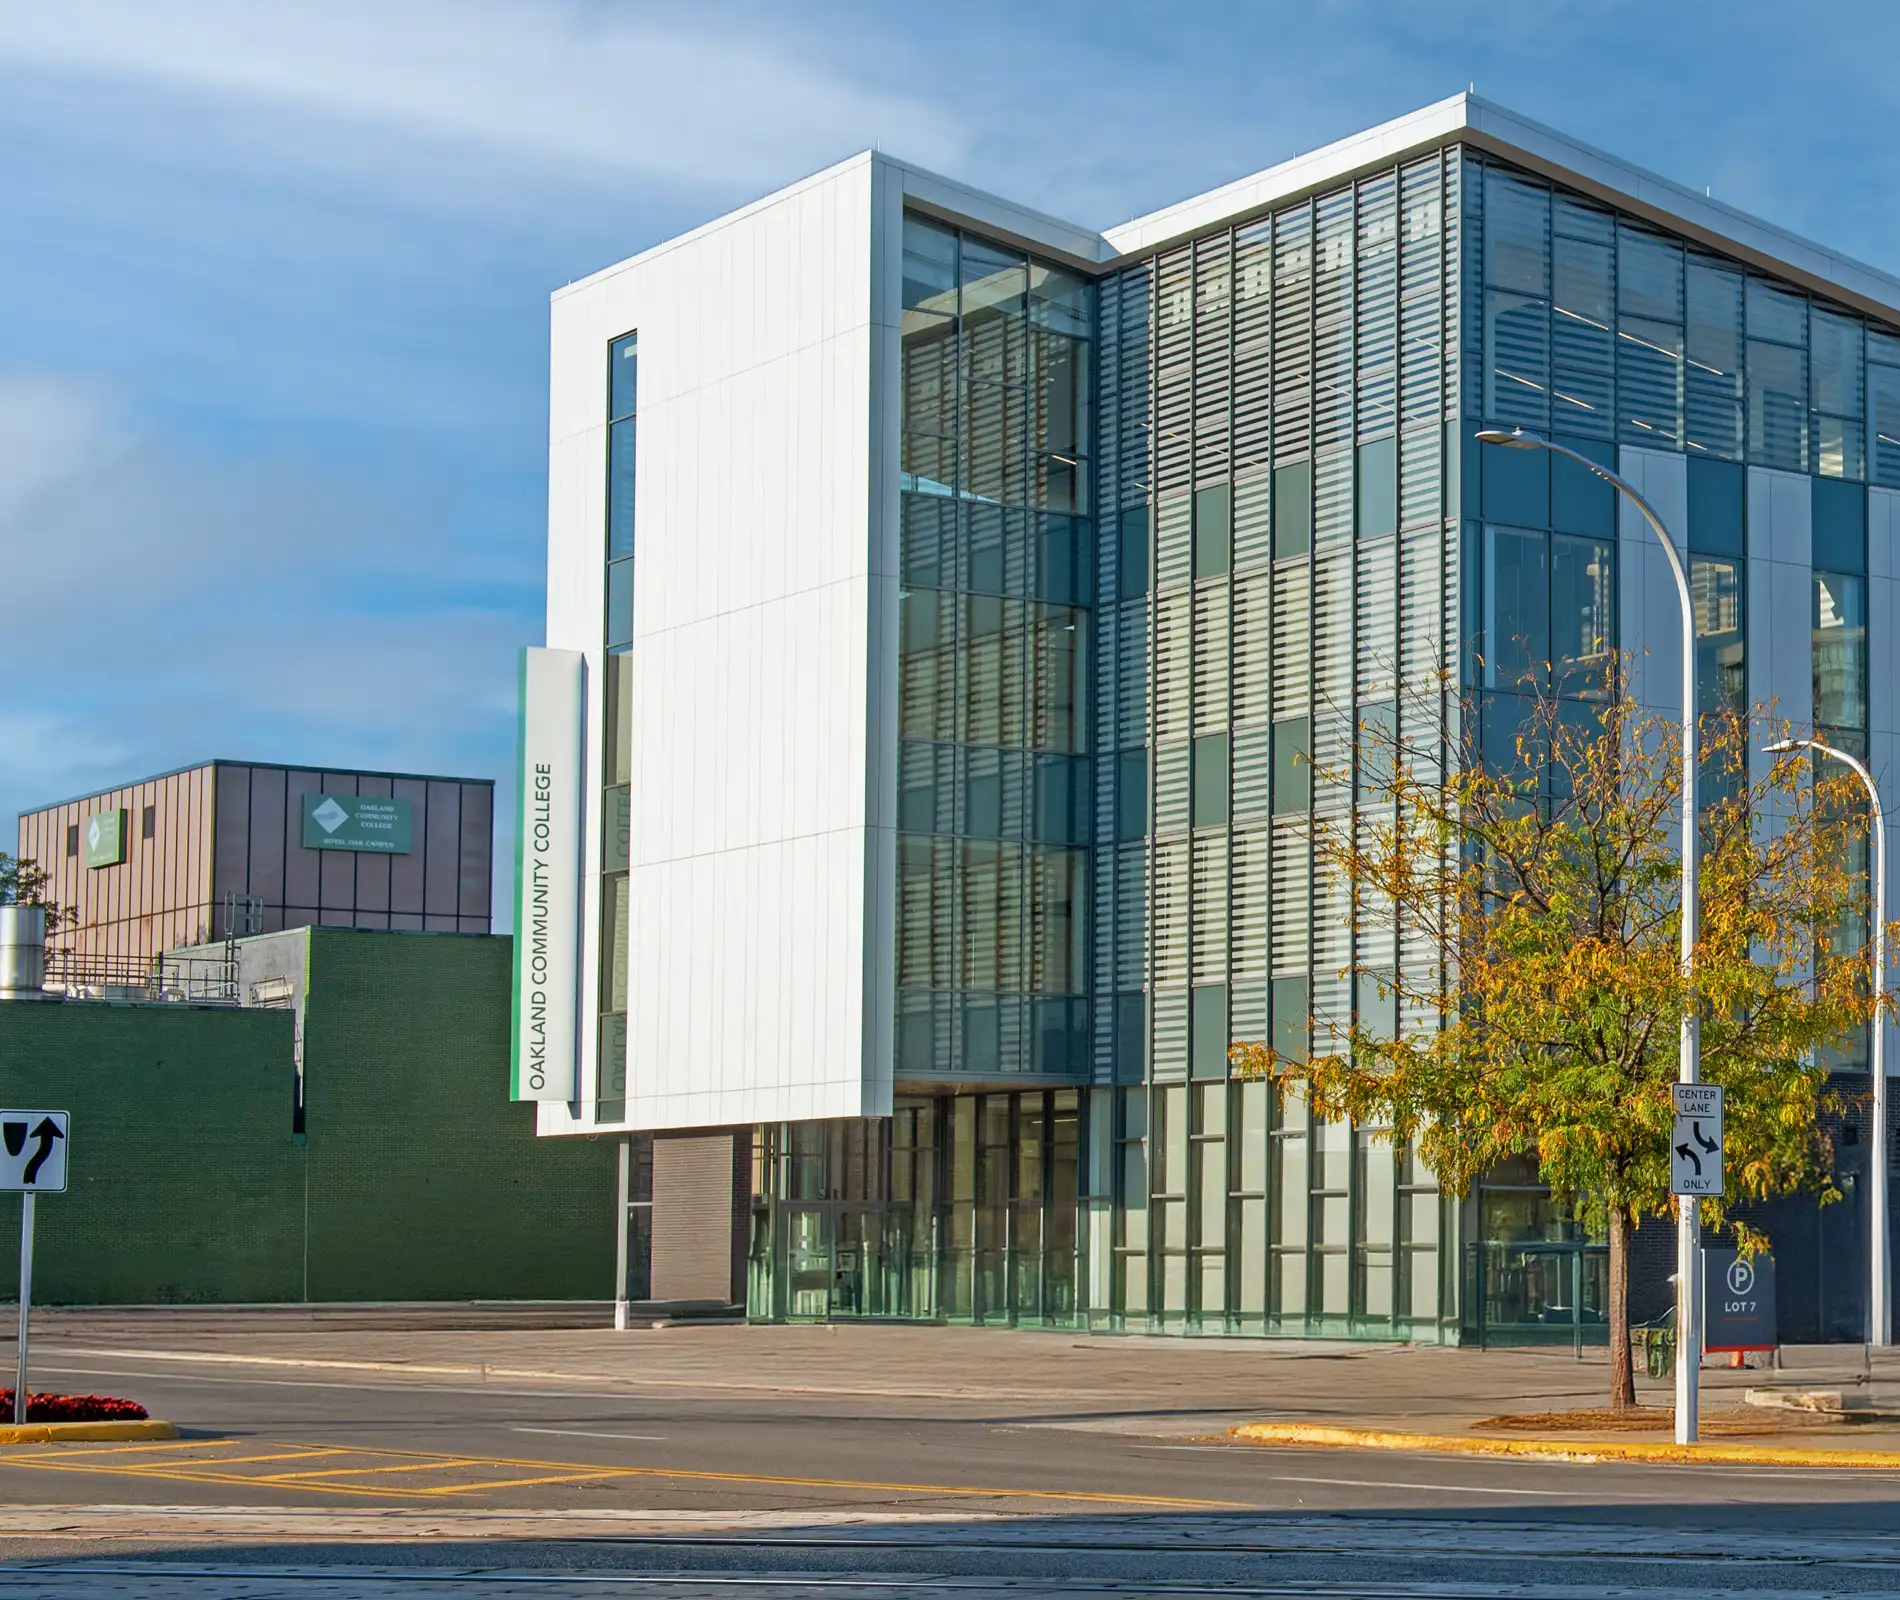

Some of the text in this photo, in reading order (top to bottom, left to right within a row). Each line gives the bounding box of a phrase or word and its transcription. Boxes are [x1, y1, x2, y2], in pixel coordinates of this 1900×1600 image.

[360, 804, 395, 812] OAKLAND
[355, 813, 399, 821] COMMUNITY
[360, 821, 393, 829] COLLEGE
[323, 838, 395, 848] ROYAL OAK CAMPUS
[529, 763, 551, 1091] OAKLAND COMMUNITY COLLEGE
[1678, 1089, 1716, 1100] CENTER
[1684, 1103, 1711, 1113] LANE
[1683, 1179, 1711, 1190] ONLY
[1735, 1267, 1748, 1288] P
[1724, 1301, 1757, 1313] LOT 7
